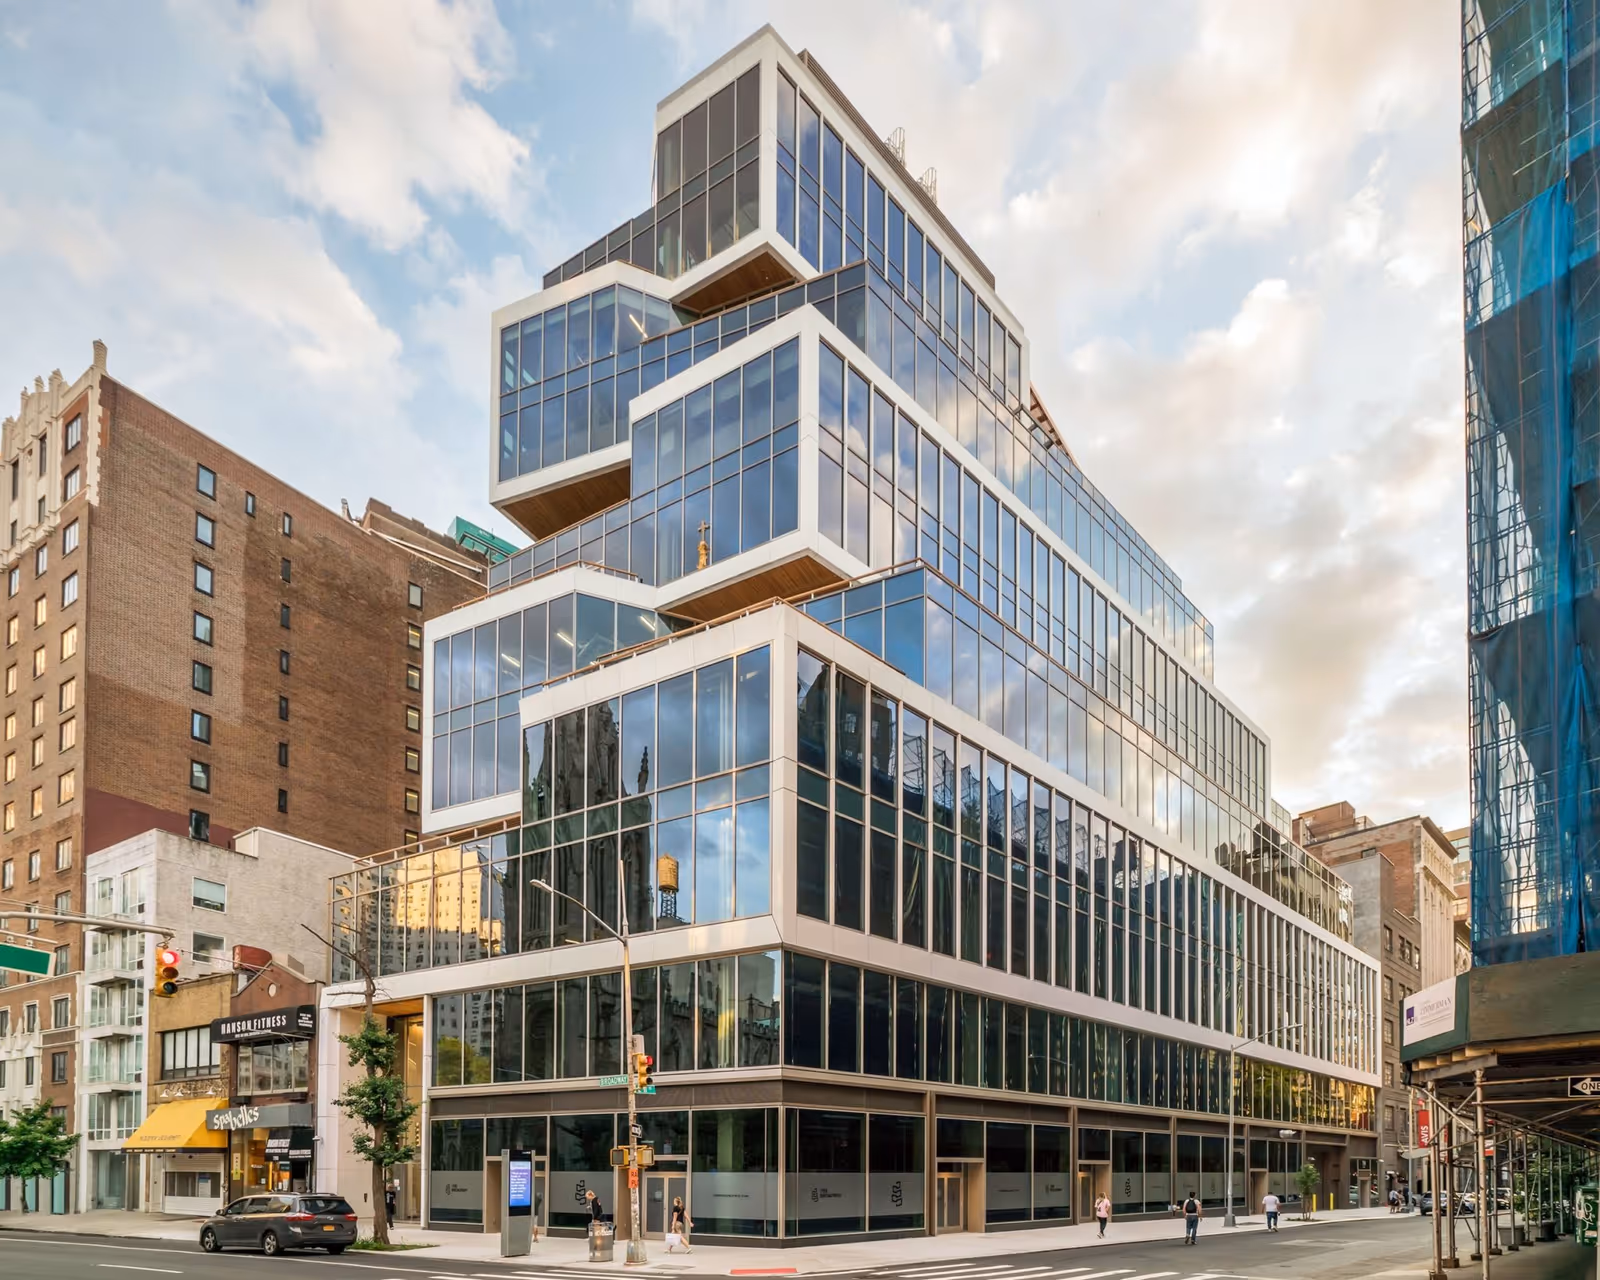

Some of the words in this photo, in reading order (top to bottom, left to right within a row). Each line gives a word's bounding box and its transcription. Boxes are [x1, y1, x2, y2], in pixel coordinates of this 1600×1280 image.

[221, 1020, 252, 1035] HANSON
[253, 1015, 287, 1030] FITNESS
[601, 1075, 628, 1085] BROADWAY
[213, 1105, 260, 1131] Spabelles
[1420, 1125, 1429, 1146] AVIS
